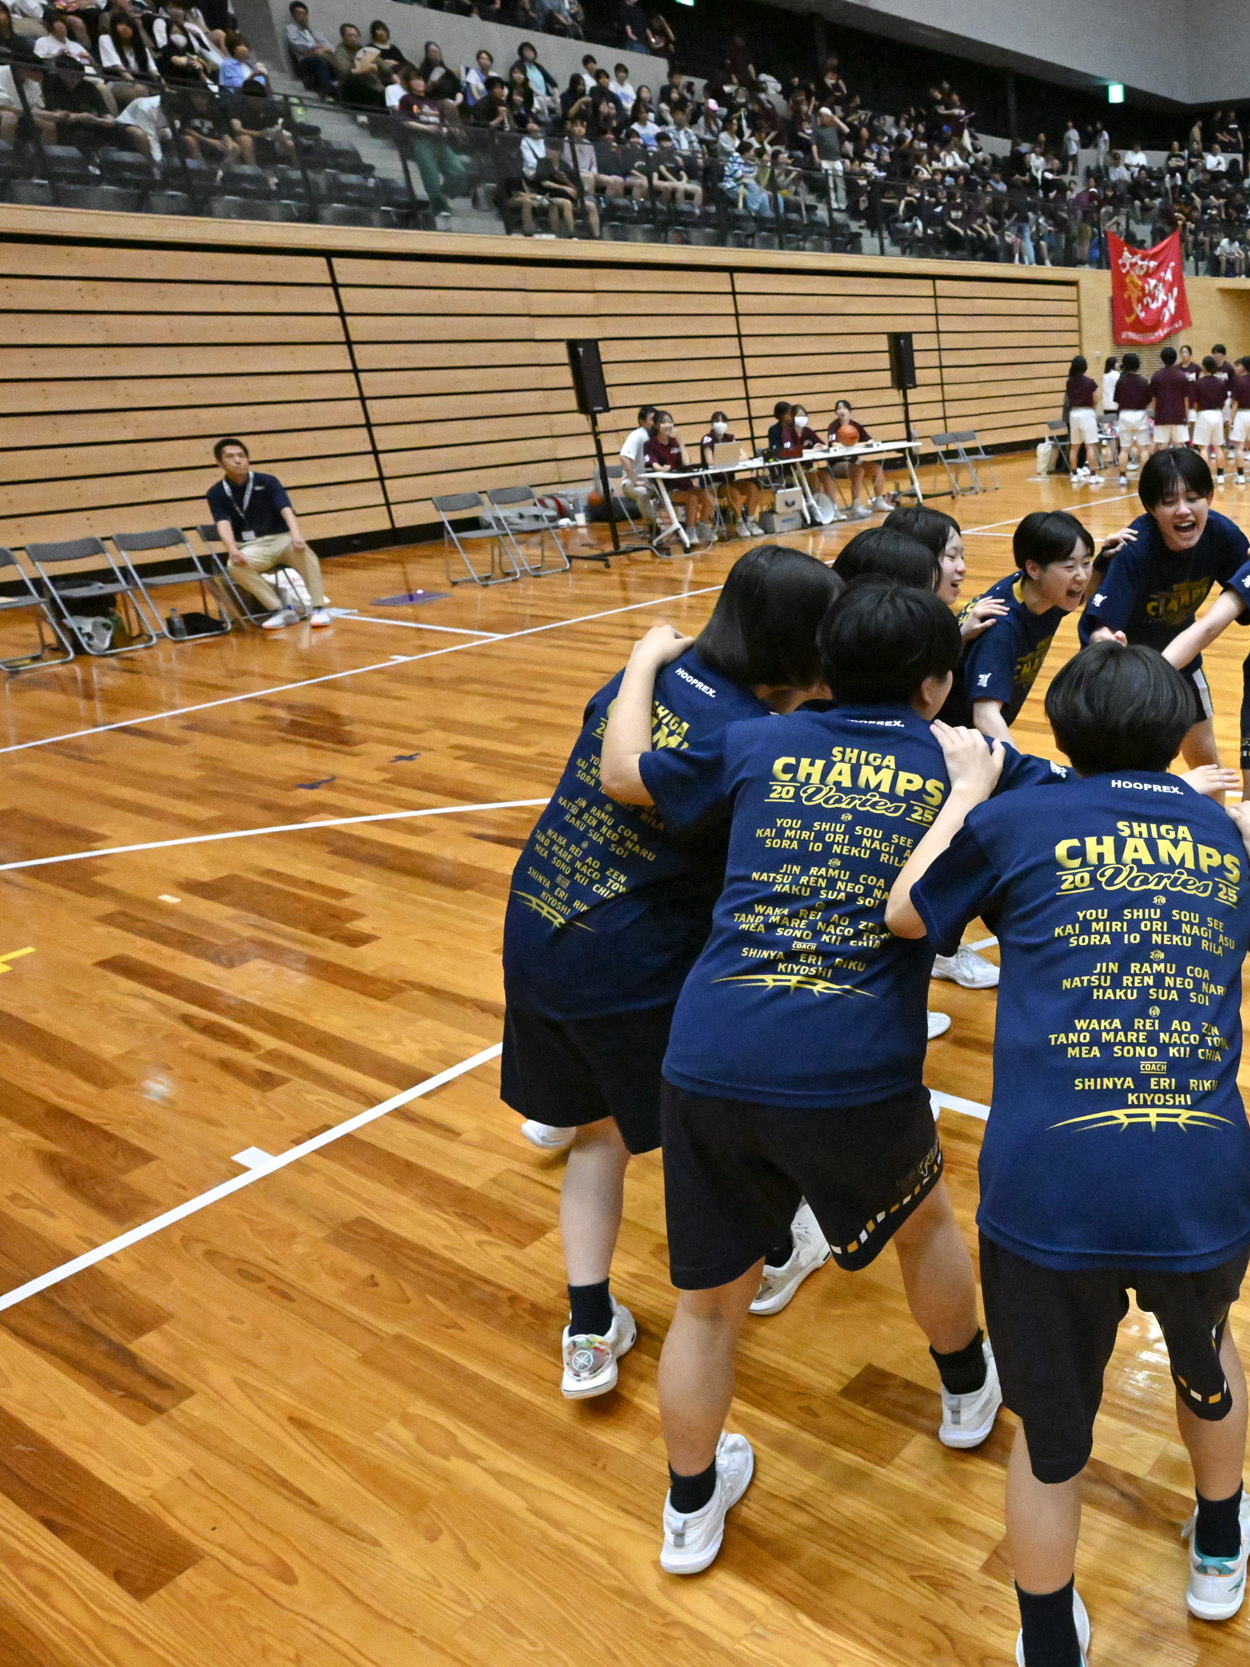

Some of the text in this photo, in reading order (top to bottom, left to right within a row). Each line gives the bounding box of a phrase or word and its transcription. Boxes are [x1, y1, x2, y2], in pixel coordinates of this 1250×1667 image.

[576, 758, 588, 770] KAI
[831, 747, 896, 769] SHIGA
[576, 770, 595, 786] SORA
[772, 757, 944, 806] CHAMPS
[769, 786, 795, 798] 20
[911, 807, 934, 822] 25
[558, 796, 656, 861] NATSU REN NEO NARU
[575, 797, 639, 842] JIN RAMU COA
[564, 814, 629, 859] HAKU SUA SOI
[756, 829, 895, 853] KAI MIRI ORI NAGI
[776, 818, 914, 847] YOU SHIU SOU SEE
[1117, 821, 1193, 841] SHIGA
[534, 843, 548, 859] MEA
[551, 857, 571, 874] SONO
[535, 830, 601, 880] TANO MARE NACO
[547, 828, 627, 884] WAKA REI AO ZEN
[765, 839, 798, 849] SORA
[832, 845, 870, 858] NEKU
[1055, 836, 1240, 883] CHAMPS
[527, 867, 550, 888] SHINYA
[554, 887, 568, 901] ERI
[752, 872, 864, 894] NATSU REN NEO
[779, 864, 885, 888] JIN RAMU COA
[773, 884, 811, 896] HAKU
[819, 890, 846, 901] SUA
[1061, 872, 1090, 890] 20
[1218, 884, 1238, 903] 25
[540, 891, 571, 915] KIYOSHI
[734, 913, 854, 936] TANO MARE NACO
[754, 904, 849, 926] WAKA REI AO
[1077, 909, 1224, 932] YOU SHIU SOU SEE
[739, 923, 765, 933] MEA
[775, 928, 812, 940] SONO
[1054, 921, 1235, 949] KAI MIRI ORI NAGI ASU
[741, 947, 784, 960] SHINYA
[799, 954, 822, 965] ERI
[1069, 934, 1111, 947] SORA
[1152, 934, 1191, 946] NEKU
[1202, 940, 1223, 957] RILA
[777, 963, 832, 978] KIYOSHI
[1093, 963, 1210, 980] JIN RAMU COA
[1062, 976, 1110, 990] NATSU
[1123, 976, 1153, 986] REN
[1165, 976, 1193, 989] NEO
[1093, 989, 1209, 1006] HAKU SUA SOI
[1075, 1019, 1191, 1031] WAKA REI AO
[1049, 1032, 1199, 1045] TANO MARE NACO
[1068, 1047, 1100, 1058] MEA
[1114, 1046, 1158, 1057] SONO
[1198, 1049, 1221, 1061] CHIA
[1074, 1078, 1134, 1090] SHINYA
[1151, 1078, 1175, 1089] ERI
[1128, 1093, 1191, 1105] KIYOSHI
